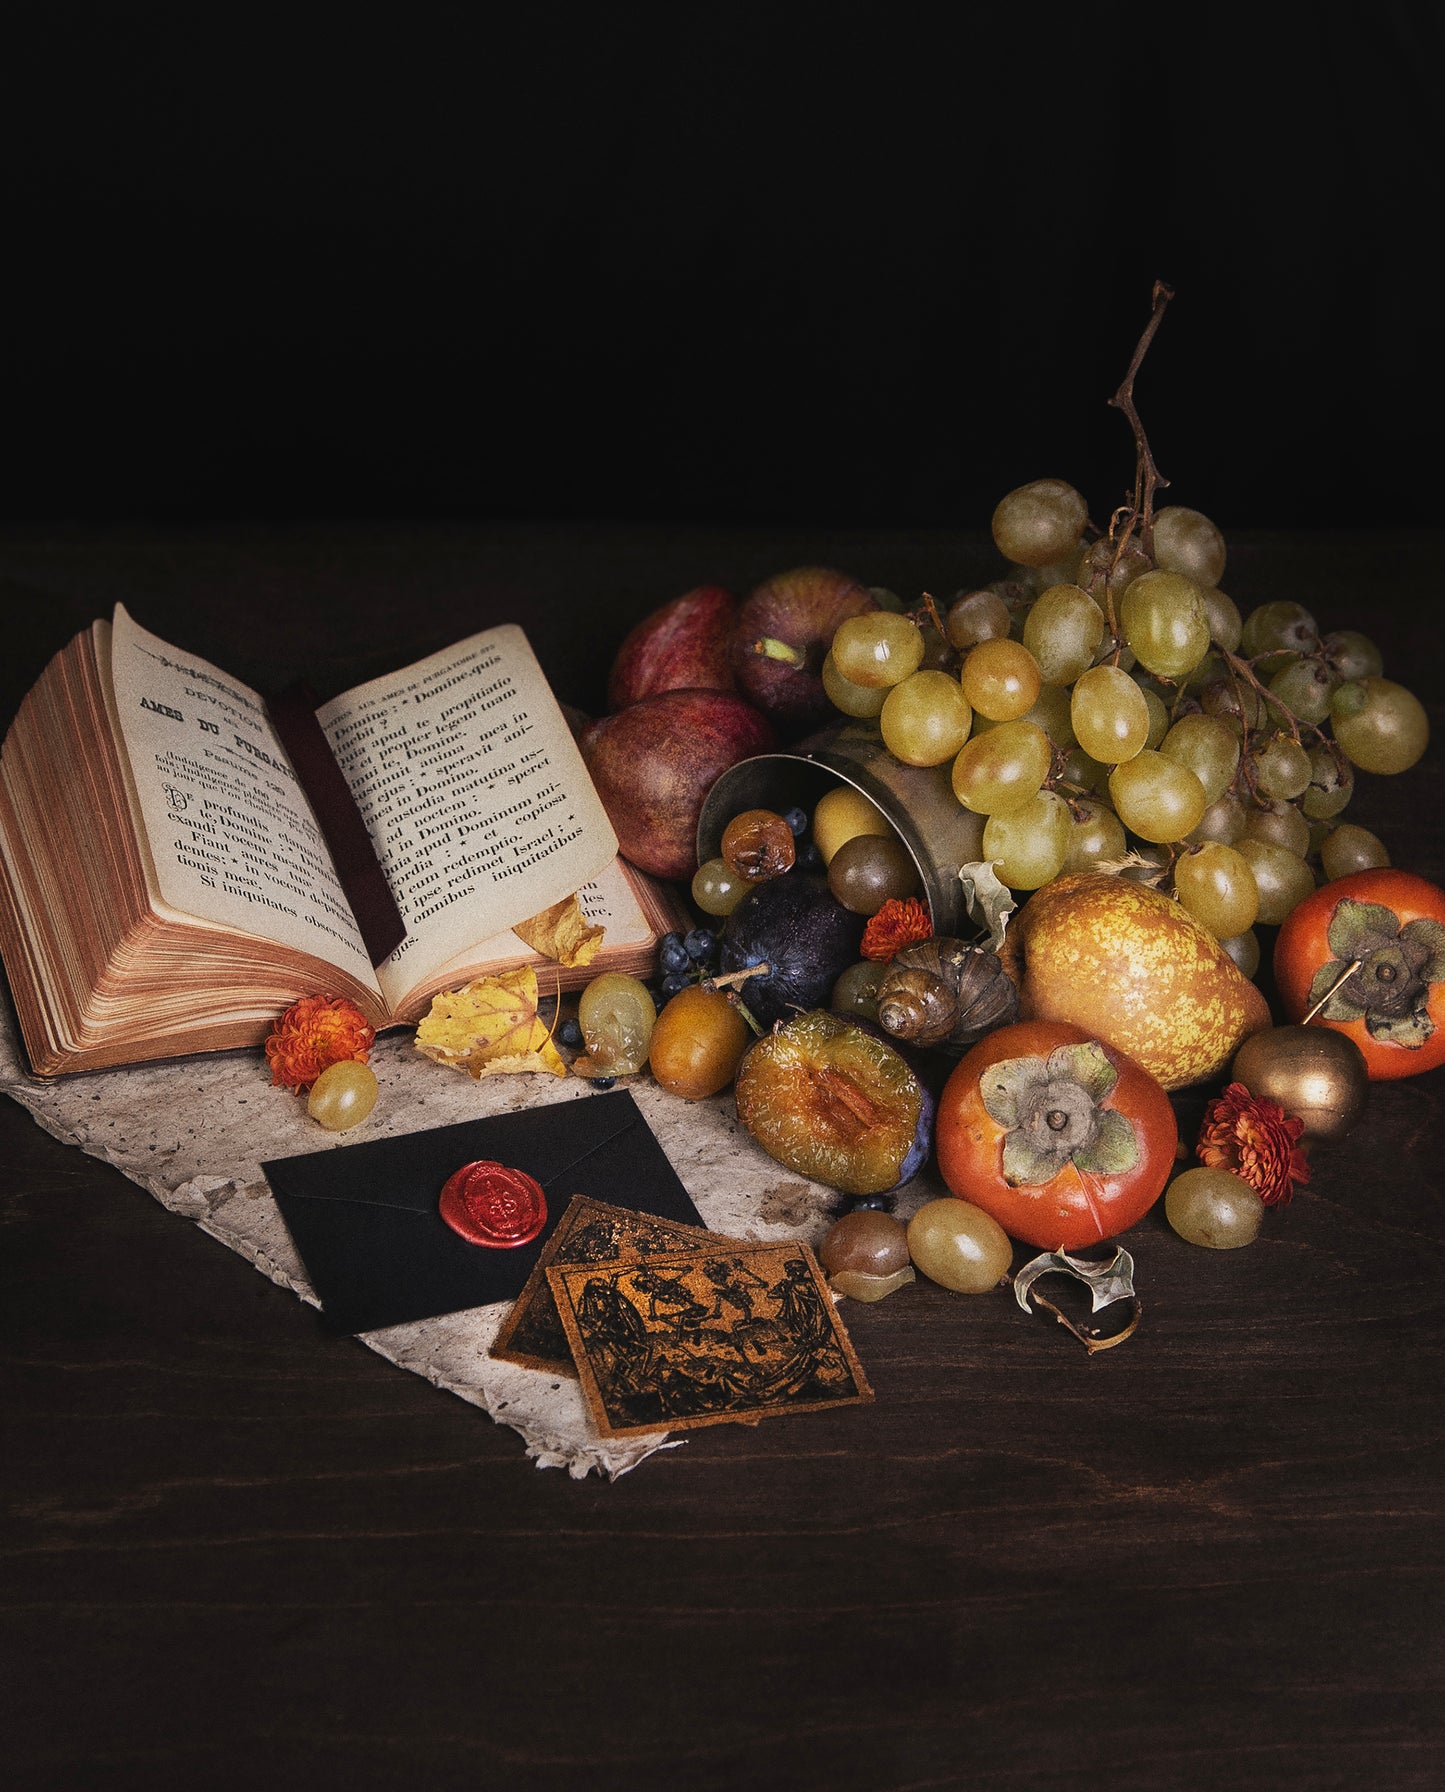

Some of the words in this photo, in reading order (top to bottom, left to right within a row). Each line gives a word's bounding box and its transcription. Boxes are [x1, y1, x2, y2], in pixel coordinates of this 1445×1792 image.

[140, 697, 184, 722] AMES
[197, 718, 219, 735] DU
[360, 756, 373, 768] et
[379, 731, 432, 760] propter
[435, 710, 478, 735] legem
[480, 688, 517, 712] tuam
[371, 725, 408, 748] apud
[416, 719, 430, 729] te
[440, 676, 512, 721] propitiatio
[420, 745, 465, 768] anima
[479, 722, 508, 742] mea
[512, 712, 528, 724] in
[203, 749, 258, 780] Psaume
[377, 783, 406, 802] ejus
[436, 744, 493, 775] speravit
[503, 725, 534, 743] ani-
[406, 732, 467, 760] Domine.
[156, 764, 170, 774] au
[173, 769, 195, 783] jour
[198, 781, 219, 793] que
[365, 805, 393, 826] mea
[396, 795, 412, 806] in
[416, 769, 478, 797] Domino.
[386, 827, 403, 844] ad
[414, 800, 466, 828] noctem
[507, 758, 551, 785] speret
[387, 795, 445, 828] custodia
[451, 762, 516, 797] matutina
[520, 748, 544, 764] us-
[203, 799, 270, 832] profundis
[278, 832, 324, 866] clamavi
[399, 839, 414, 852] in
[418, 809, 482, 840] Domino.
[415, 832, 452, 857] apud
[457, 798, 532, 837] Dominum
[536, 782, 561, 800] mi-
[483, 829, 499, 840] et
[515, 793, 567, 826] copiosa
[168, 812, 216, 835] exaudi
[223, 831, 267, 855] vocem
[272, 852, 315, 880] meam.
[174, 840, 226, 865] dentes:
[245, 862, 259, 876] in
[264, 872, 306, 897] vocem
[177, 854, 219, 875] tionis
[191, 831, 230, 853] Fiant
[241, 850, 279, 872] aures
[408, 872, 440, 893] eum
[443, 834, 523, 873] redemptio.
[413, 886, 443, 908] ipse
[447, 855, 505, 888] redimet
[512, 828, 554, 857] Israel
[200, 874, 216, 888] Si
[222, 881, 298, 917] iniquitates
[413, 884, 476, 925] omnibus
[491, 826, 584, 882] iniquitatibus
[582, 894, 605, 905] les
